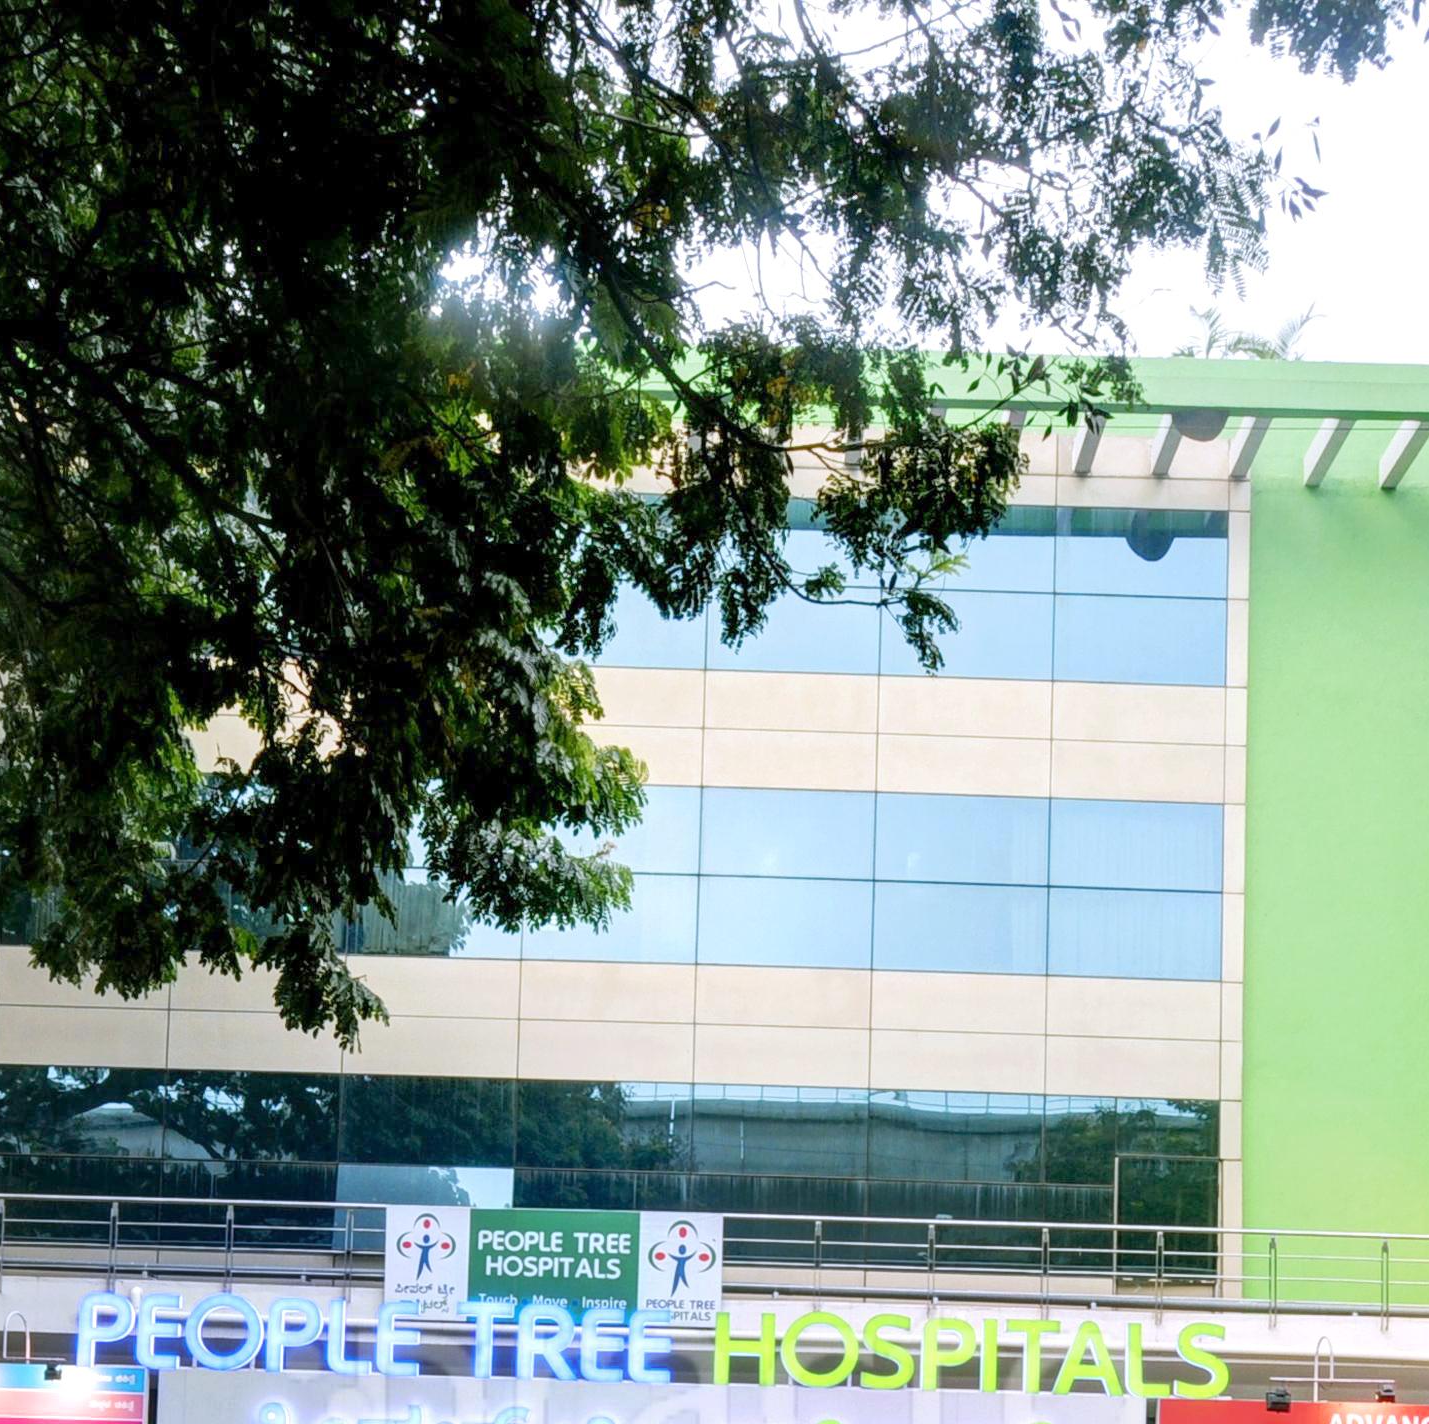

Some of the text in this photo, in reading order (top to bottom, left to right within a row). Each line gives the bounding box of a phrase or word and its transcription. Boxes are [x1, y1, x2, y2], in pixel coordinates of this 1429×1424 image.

[478, 1230, 631, 1254] PEOPLE TREE
[486, 1256, 621, 1279] HOSPITALS
[478, 1293, 627, 1309] Touch Move Inspire
[646, 1299, 716, 1310] PEOPLE TREE
[76, 1291, 1231, 1399] PEOPLE TREE HOSPITALS
